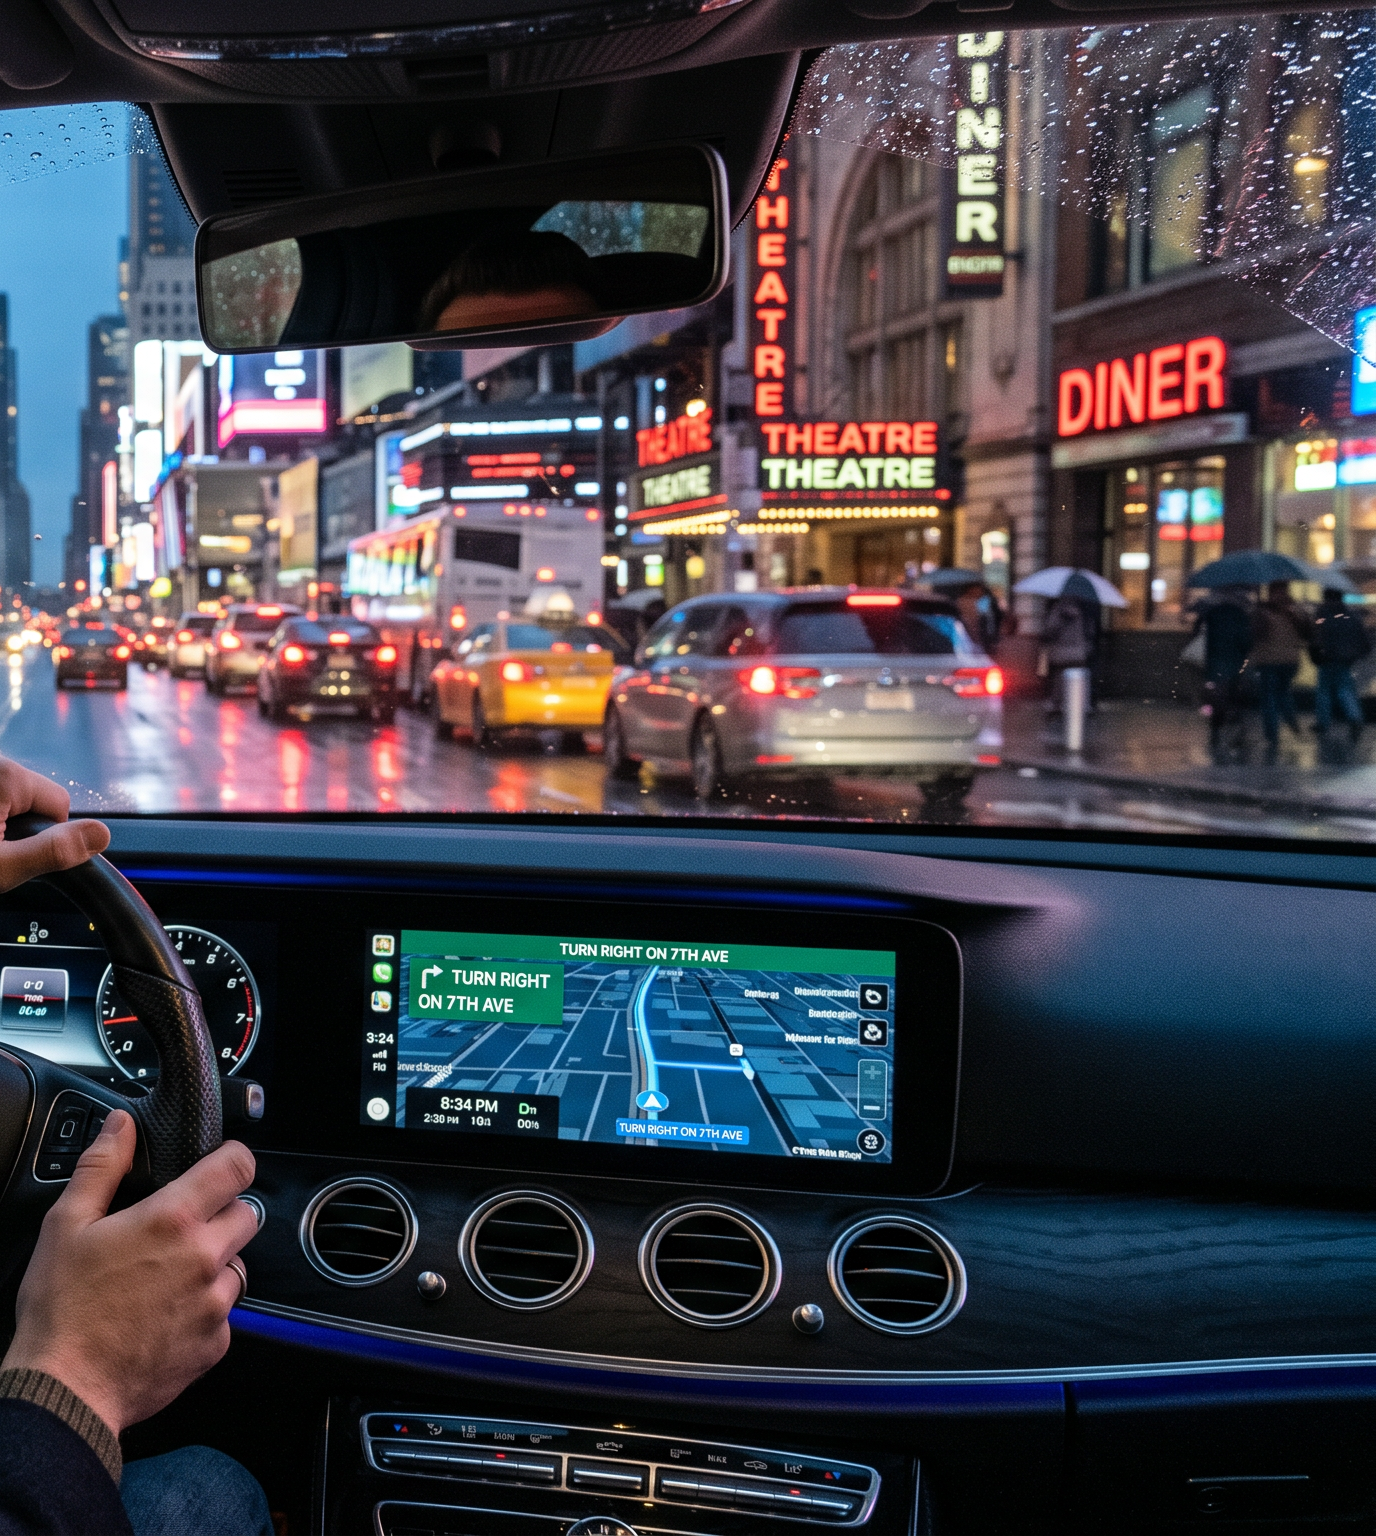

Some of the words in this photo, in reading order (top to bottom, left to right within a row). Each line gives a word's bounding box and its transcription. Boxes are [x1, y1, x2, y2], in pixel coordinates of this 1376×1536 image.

[956, 31, 1005, 243] DINER
[754, 158, 790, 417] THEATRE
[1057, 335, 1227, 438] DINER
[635, 406, 713, 469] THEATRE
[760, 421, 939, 455] THEATRE
[760, 456, 936, 490] THEATRE
[642, 464, 712, 507] THEATRE
[559, 942, 598, 957] TURN
[600, 944, 643, 959] RIGHT
[645, 946, 667, 960] ON
[670, 947, 699, 961] 7TH
[701, 950, 729, 963] AVE
[451, 969, 496, 987] TURN
[500, 971, 551, 989] RIGHT
[418, 993, 442, 1010] ON
[446, 995, 479, 1012] 7TH
[482, 997, 514, 1014] AVE
[235, 1013, 246, 1024] 7
[123, 1041, 133, 1051] 0
[366, 1032, 394, 1045] 3:24
[221, 1048, 232, 1058] 8
[440, 1096, 473, 1112] 8:34
[475, 1098, 499, 1114] PM
[619, 1122, 646, 1134] TURN
[647, 1124, 678, 1136] RIGHT
[680, 1126, 697, 1138] ON
[699, 1127, 720, 1139] 7TH
[721, 1129, 743, 1141] AVE
